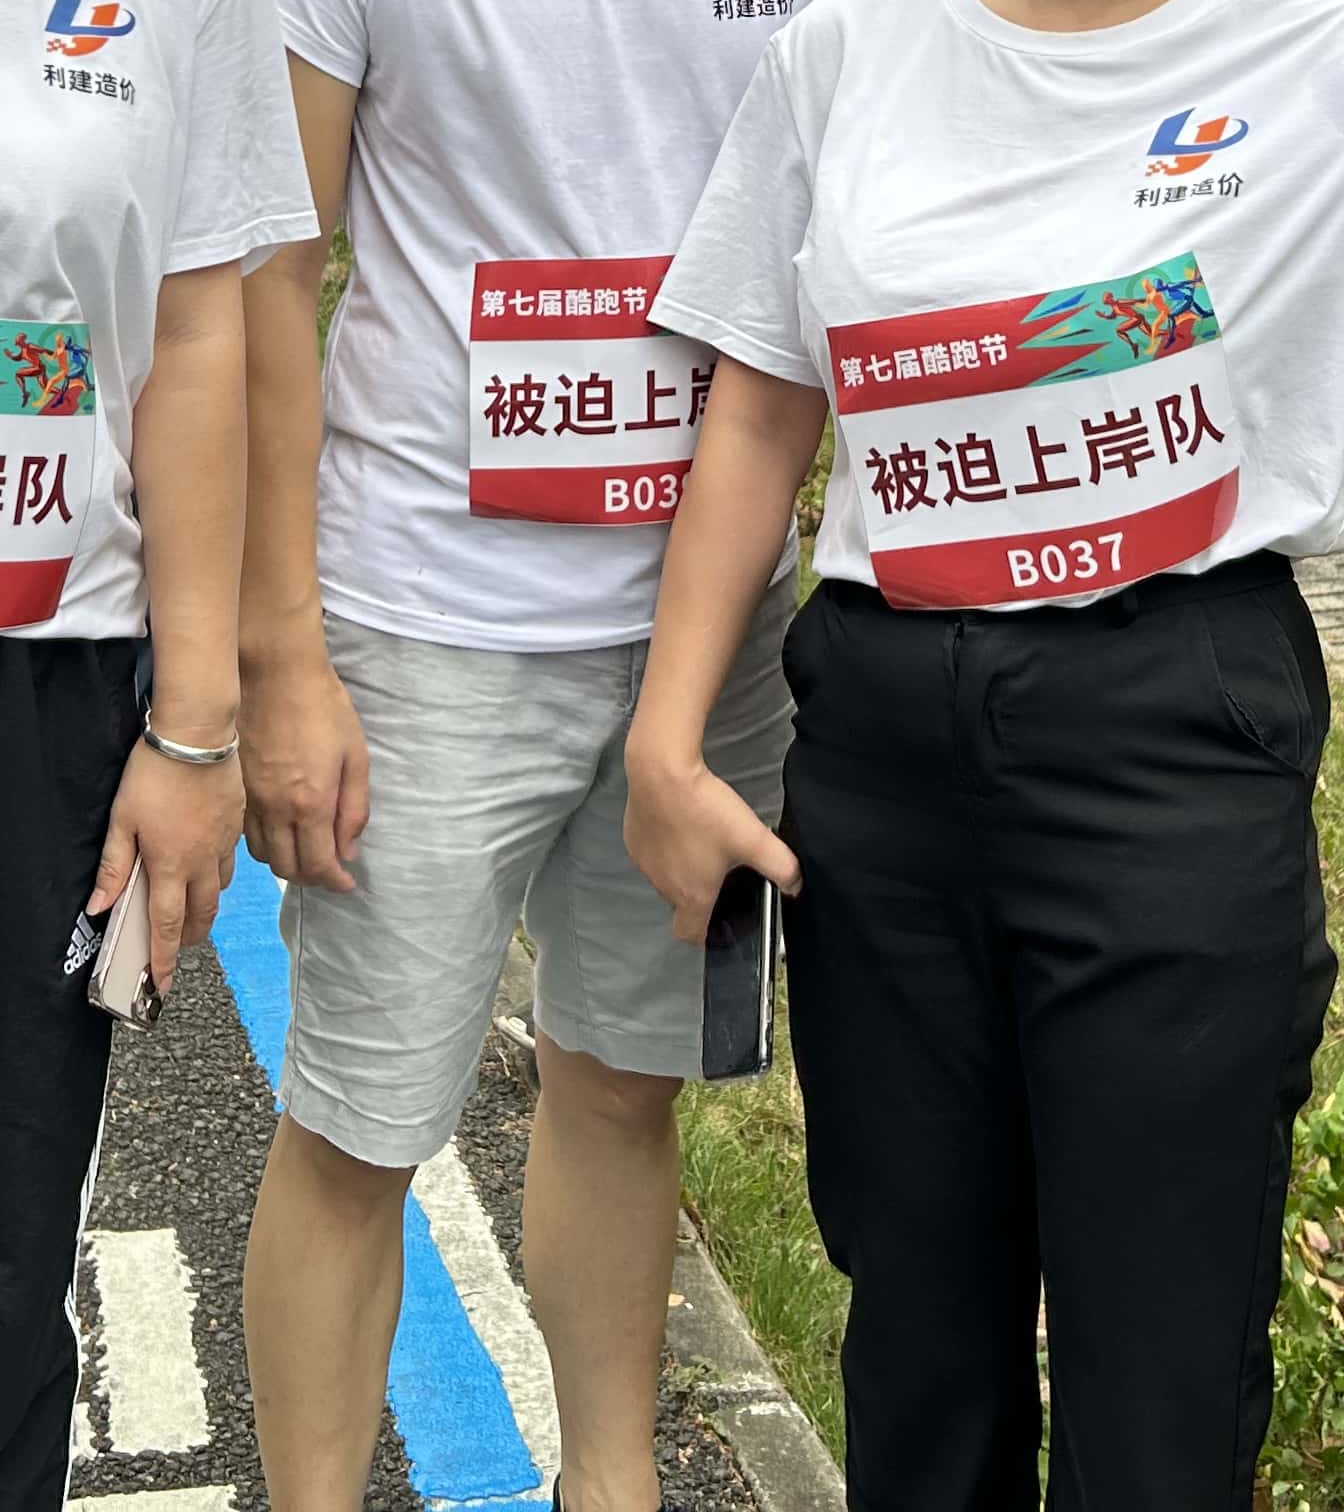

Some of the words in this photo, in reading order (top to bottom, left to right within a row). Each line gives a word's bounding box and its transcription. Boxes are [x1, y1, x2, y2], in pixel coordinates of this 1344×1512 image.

[43, 64, 136, 105] 利建造价
[1134, 172, 1244, 208] 利建造价
[481, 286, 648, 317] 第七届酷跑节
[839, 333, 1008, 387] 第七届酷跑节
[865, 383, 1226, 515] 被迫上岸队
[605, 471, 690, 513] B03
[1007, 531, 1126, 588] B037
